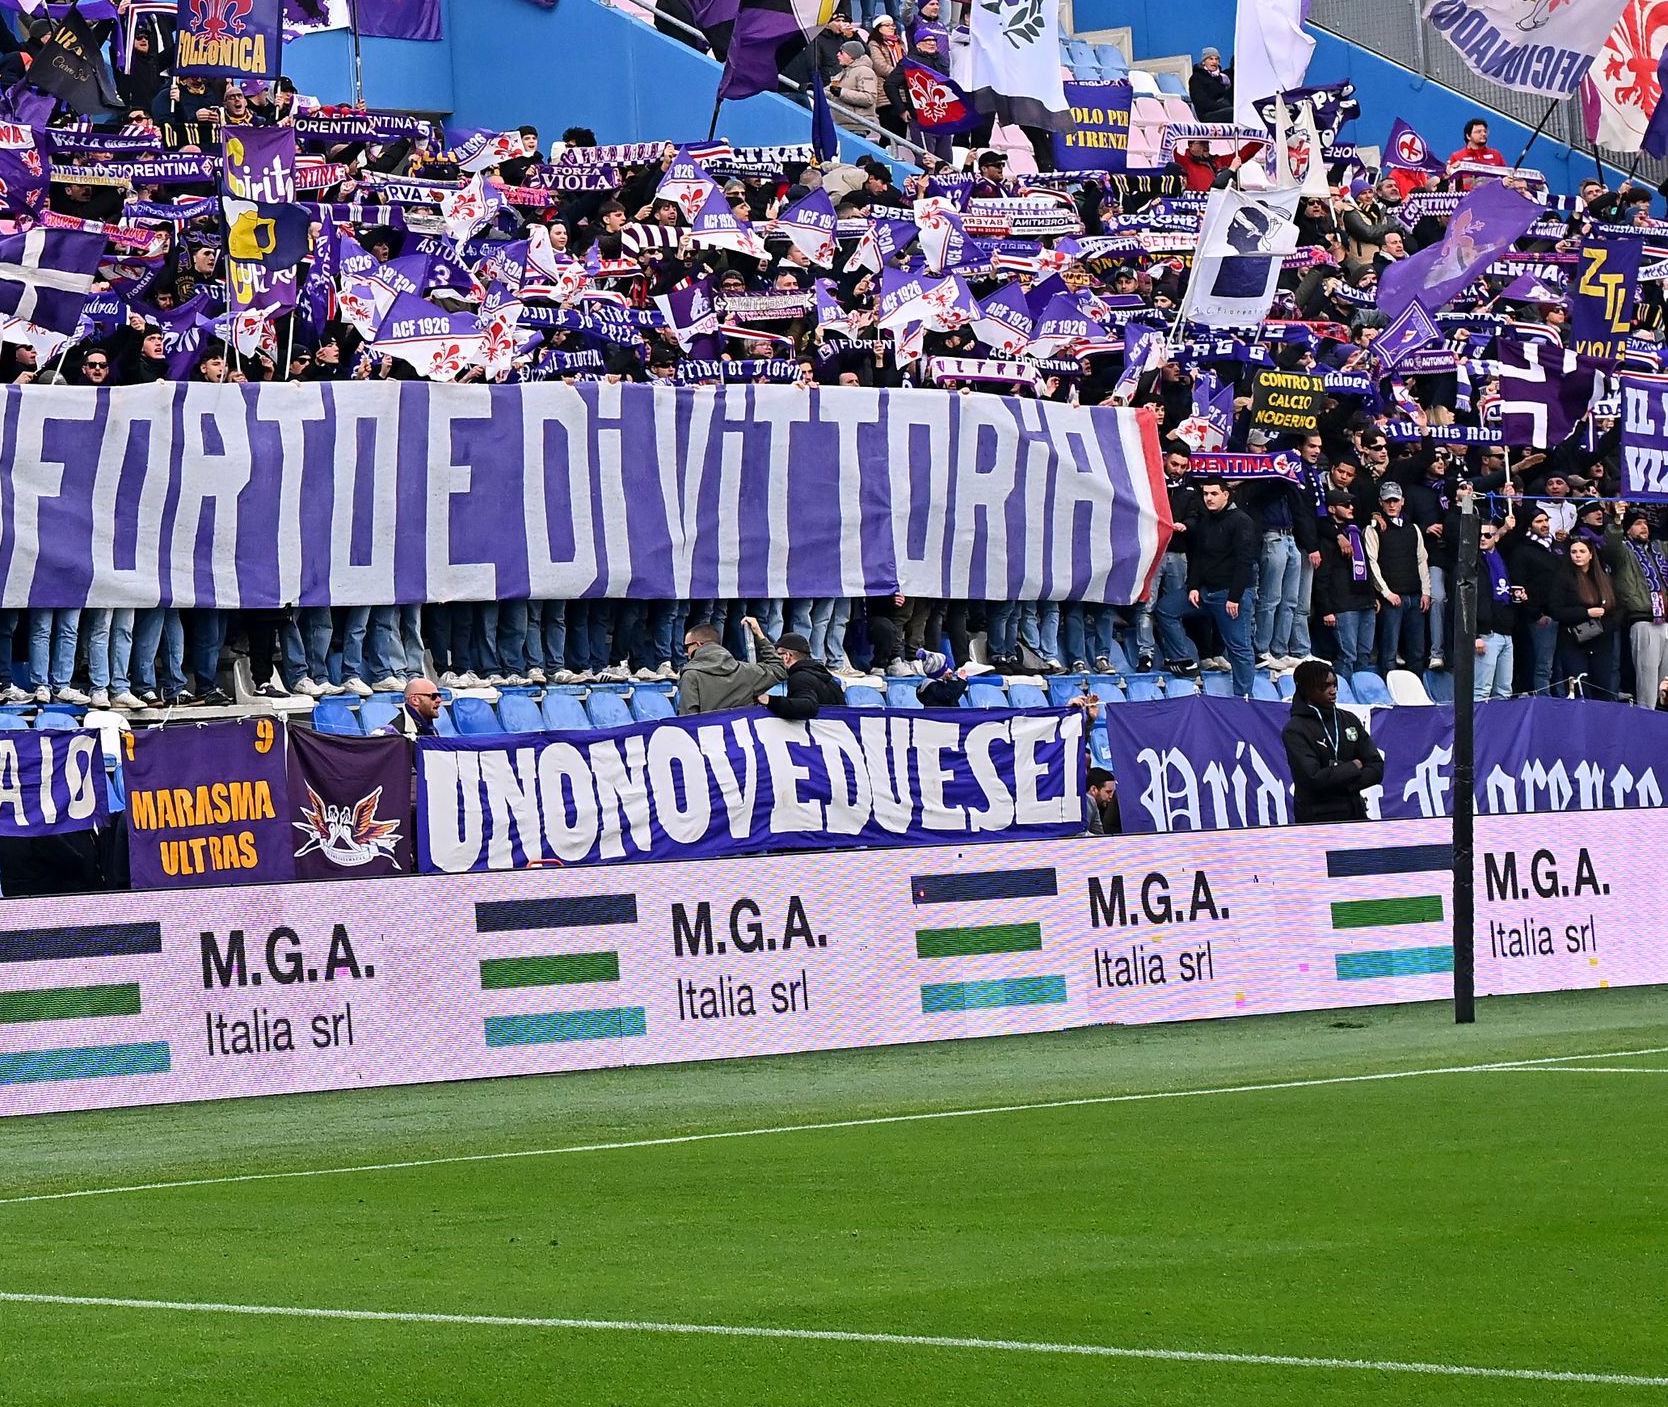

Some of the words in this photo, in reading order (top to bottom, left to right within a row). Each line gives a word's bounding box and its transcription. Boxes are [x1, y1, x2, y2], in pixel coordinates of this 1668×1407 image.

[543, 174, 614, 191] VIOLA
[392, 320, 415, 335] ACF
[417, 318, 450, 335] 1926
[1268, 392, 1313, 410] CALCIO
[131, 778, 275, 832] MARASMA
[424, 710, 1084, 873] UNONOVEDUESEI
[159, 830, 259, 878] ULTRAS
[1484, 847, 1611, 901] M.G.A.
[1088, 869, 1230, 928] M.G.A.
[672, 895, 828, 957] M.G.A.
[1489, 918, 1553, 959] Italia
[1565, 914, 1596, 955] srl
[200, 923, 375, 989] M.G.A.
[1092, 943, 1165, 988] Italia
[1179, 941, 1213, 981] srl
[676, 973, 757, 1021] Italia
[770, 969, 810, 1013] srl
[206, 1006, 295, 1056] Italia
[311, 1003, 355, 1048] srl
